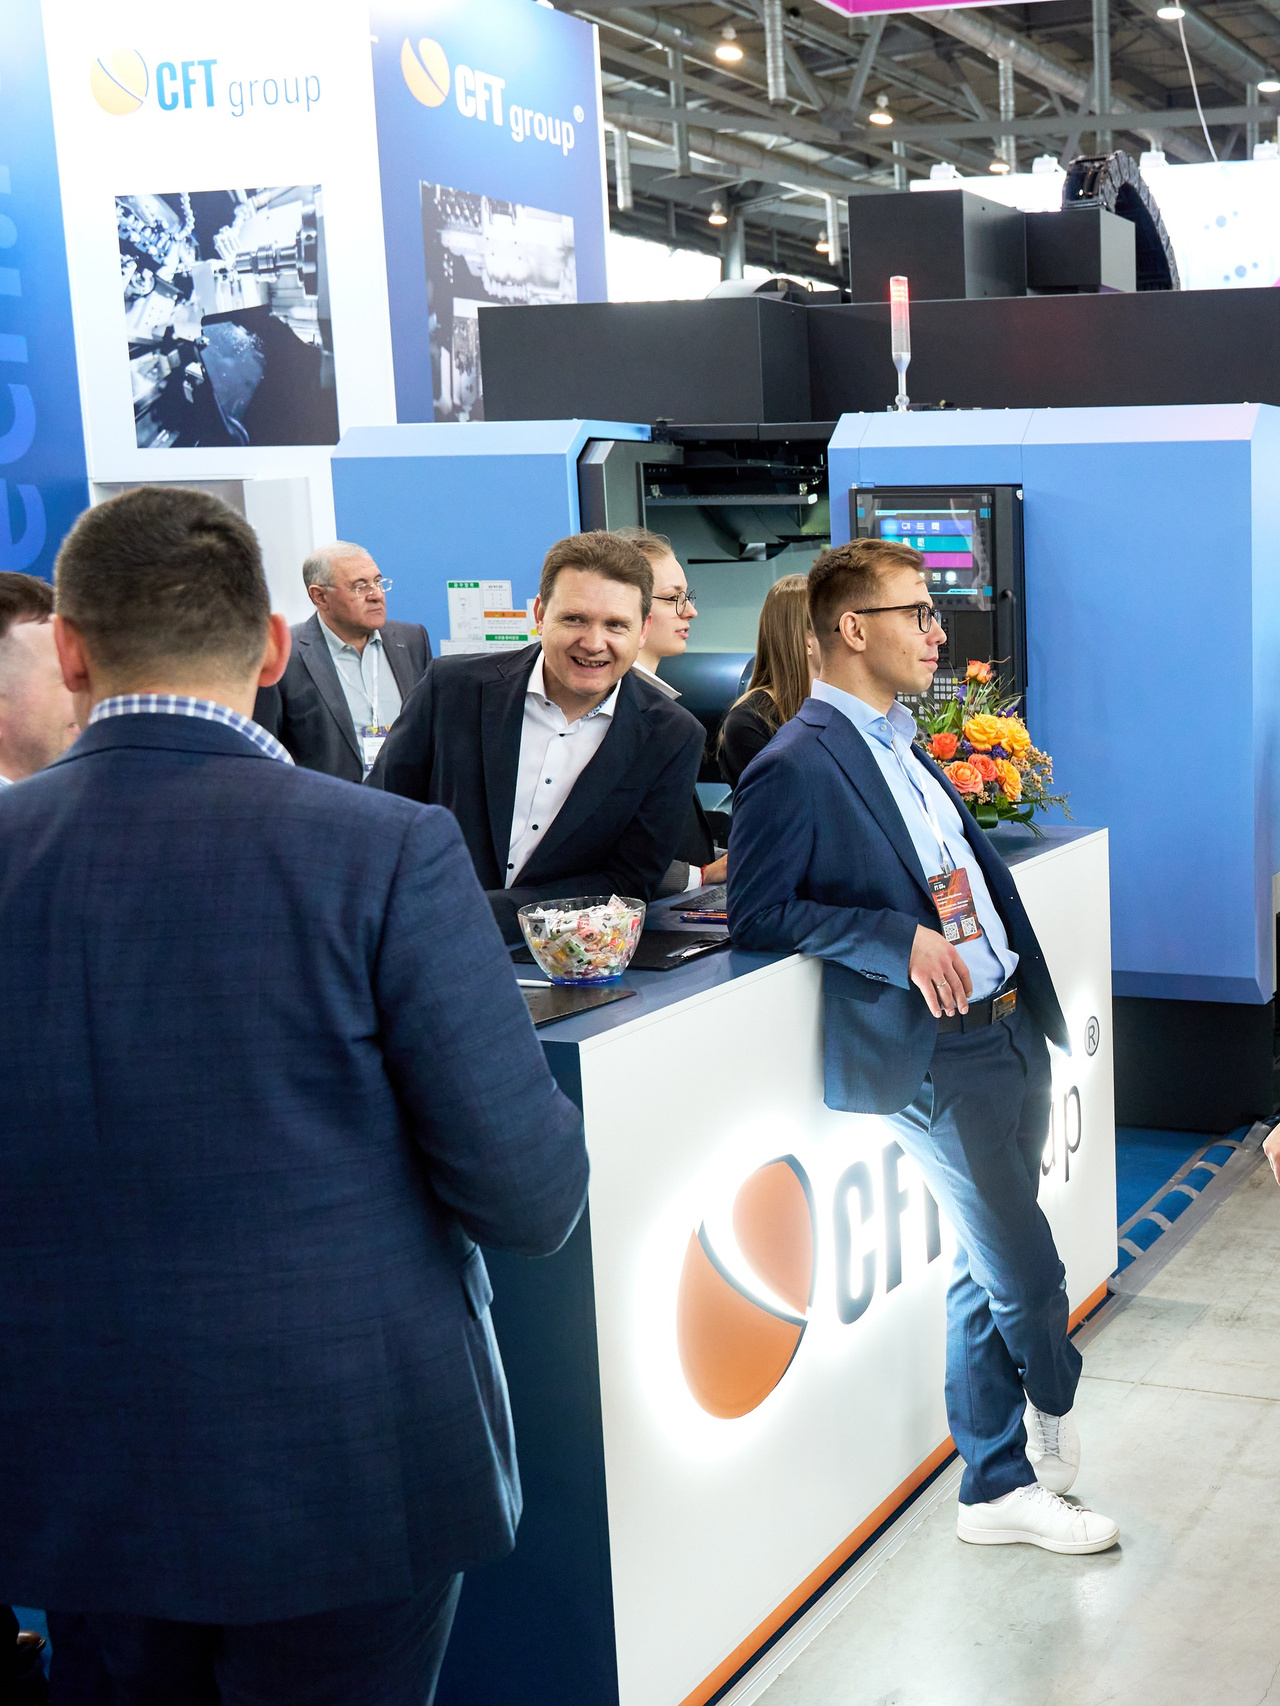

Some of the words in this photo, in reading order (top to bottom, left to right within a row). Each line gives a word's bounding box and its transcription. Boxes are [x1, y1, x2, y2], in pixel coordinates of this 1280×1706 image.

[156, 59, 218, 111] CFT
[228, 75, 321, 118] group
[454, 64, 506, 127] CFT
[509, 104, 575, 156] group
